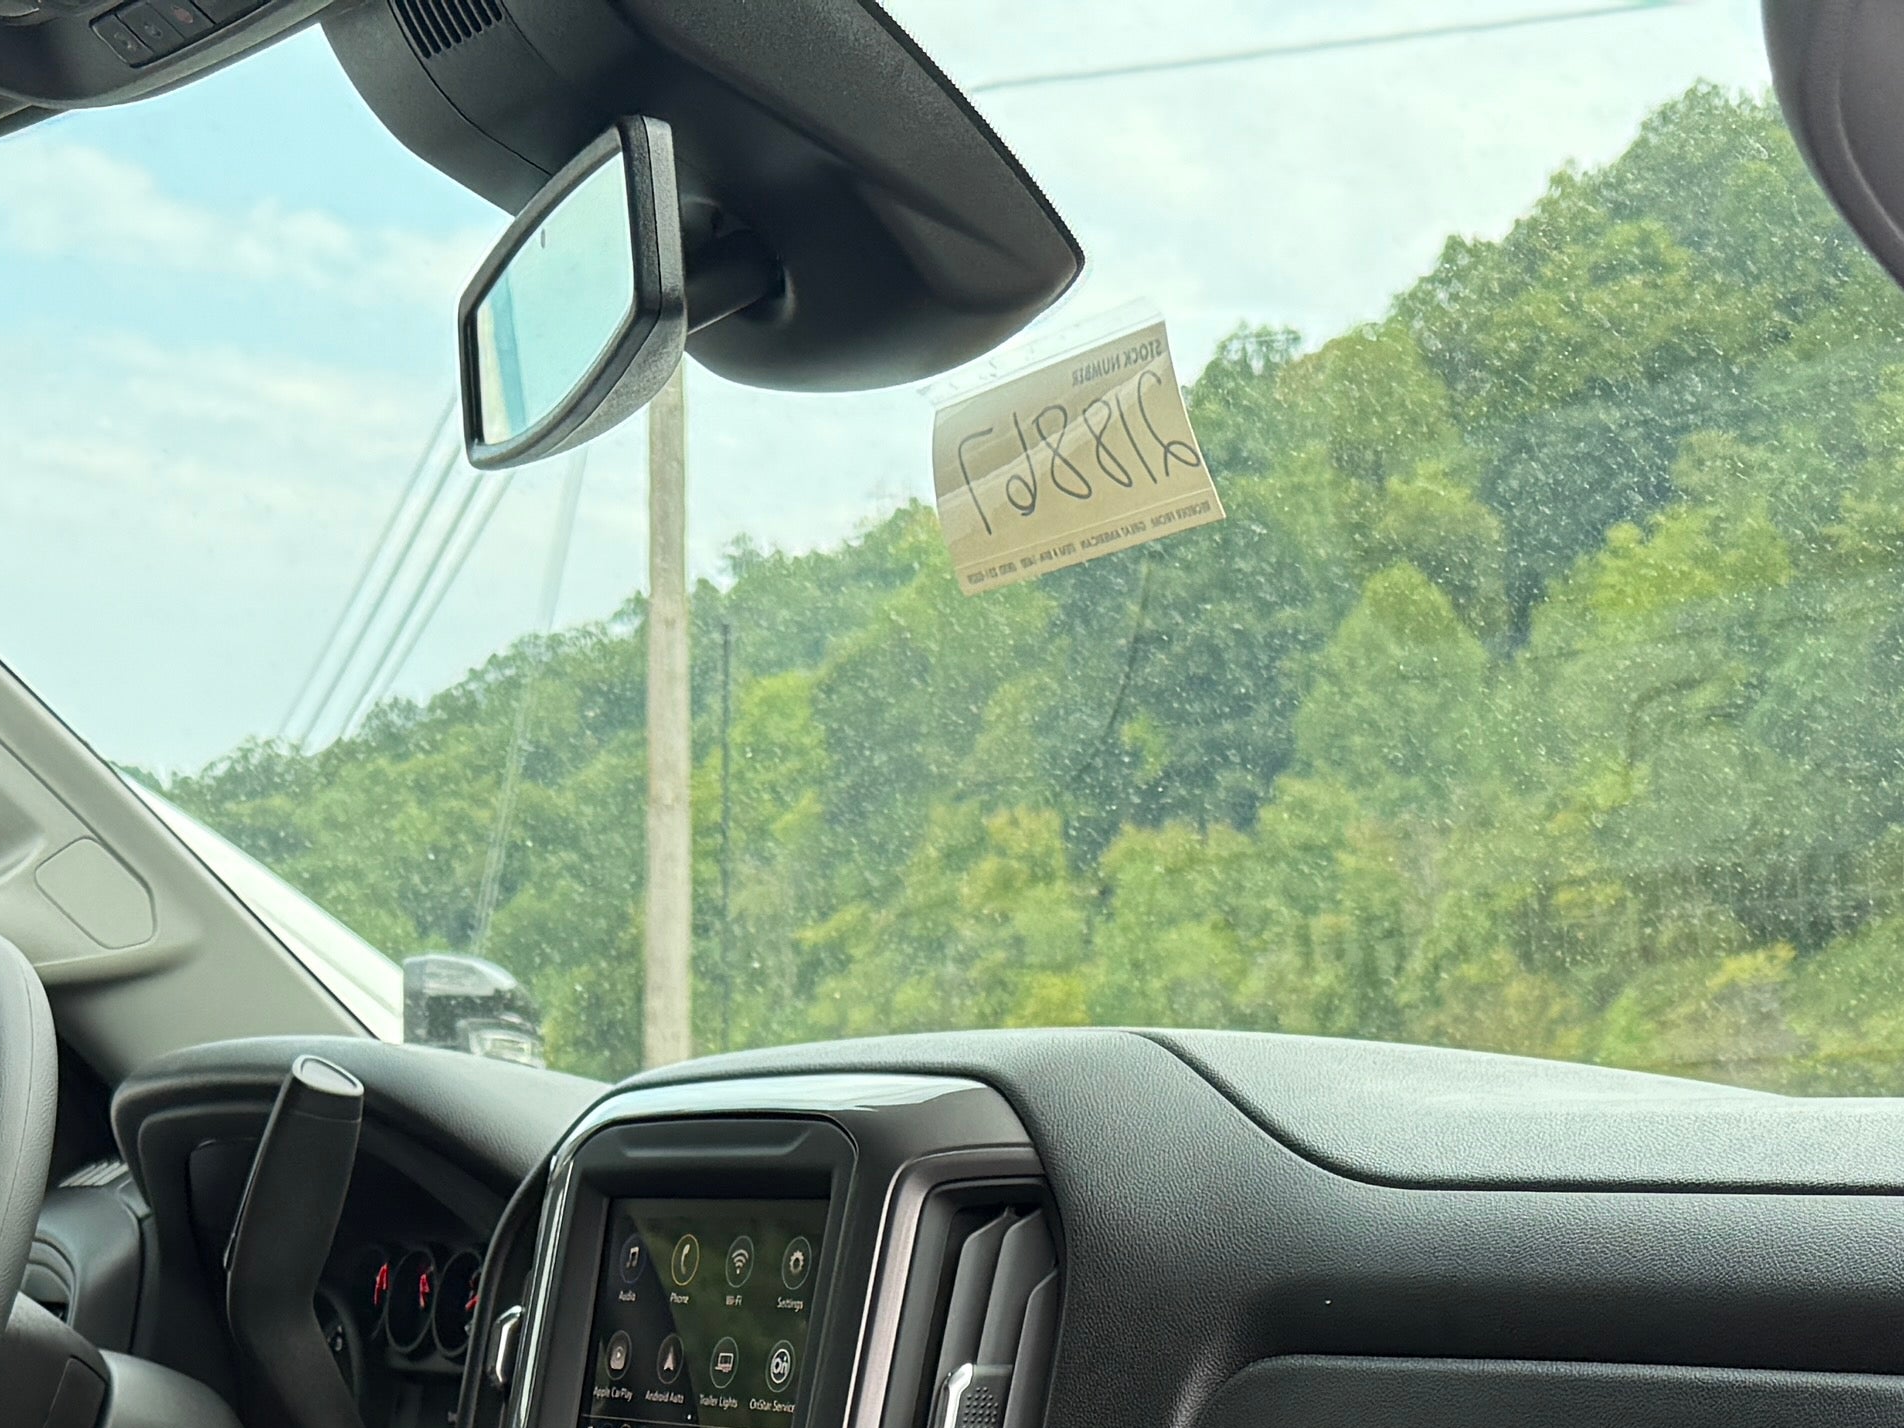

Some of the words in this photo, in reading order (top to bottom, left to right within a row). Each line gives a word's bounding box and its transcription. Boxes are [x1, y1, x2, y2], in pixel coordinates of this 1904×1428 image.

[670, 1292, 689, 1304] Phone
[777, 1296, 803, 1312] Settings
[593, 1386, 610, 1399] Apple
[611, 1387, 633, 1402] CarPlay
[645, 1390, 669, 1402] Android
[670, 1392, 684, 1404] Auto
[699, 1394, 718, 1406] Trailer
[719, 1396, 738, 1410] Lights
